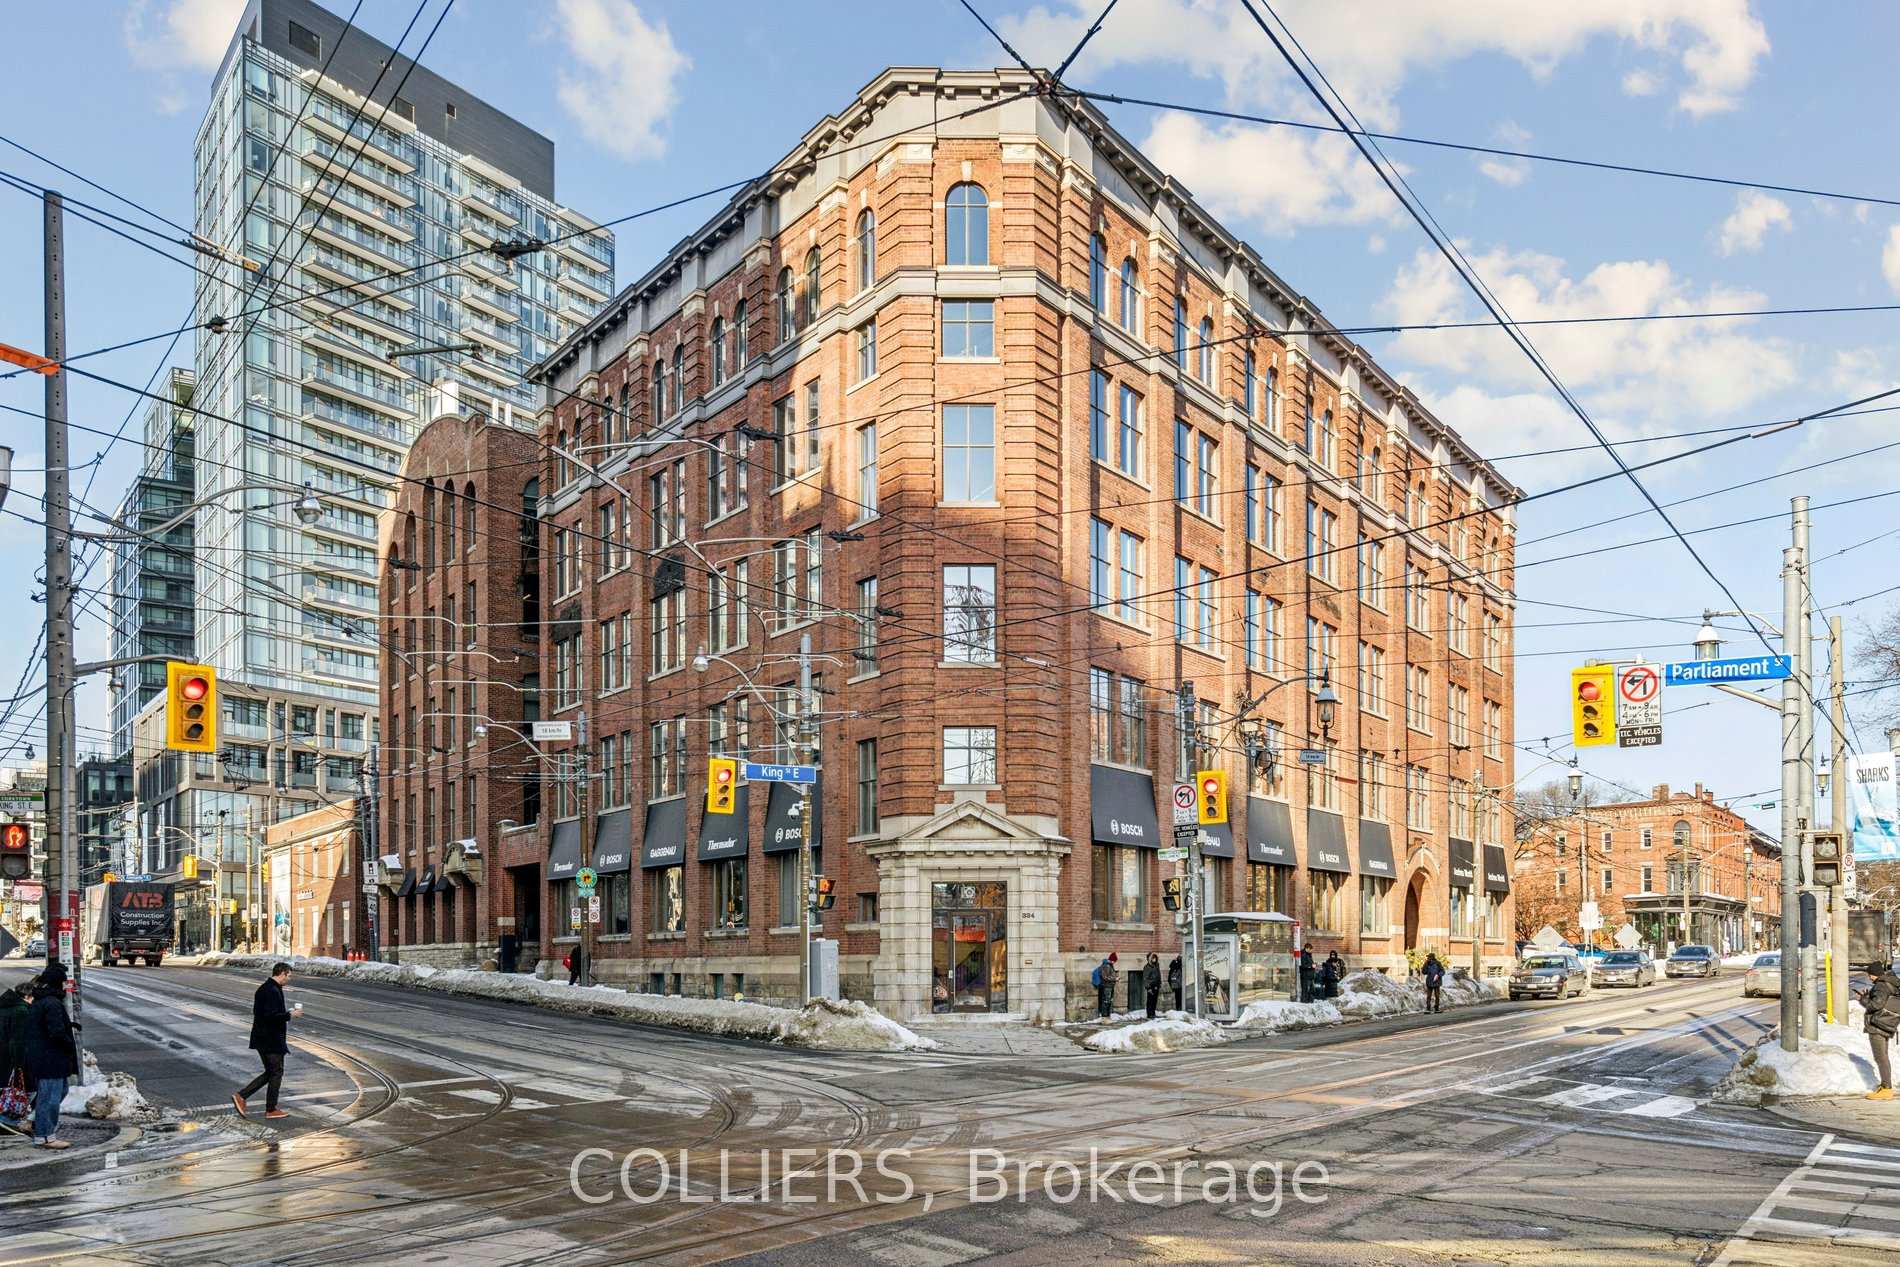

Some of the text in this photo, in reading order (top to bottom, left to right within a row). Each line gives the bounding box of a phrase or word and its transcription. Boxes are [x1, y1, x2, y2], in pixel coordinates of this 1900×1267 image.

[1672, 659, 1769, 680] Parliament
[1626, 736, 1657, 745] EXCEPTED
[761, 766, 784, 780] King
[793, 768, 800, 779] E
[1856, 766, 1889, 784] SHARKS
[785, 828, 802, 840] BOSC
[1121, 823, 1143, 836] BOSCH
[606, 853, 623, 865] BOSCH
[120, 911, 165, 919] Construction
[120, 918, 150, 927] Supplies
